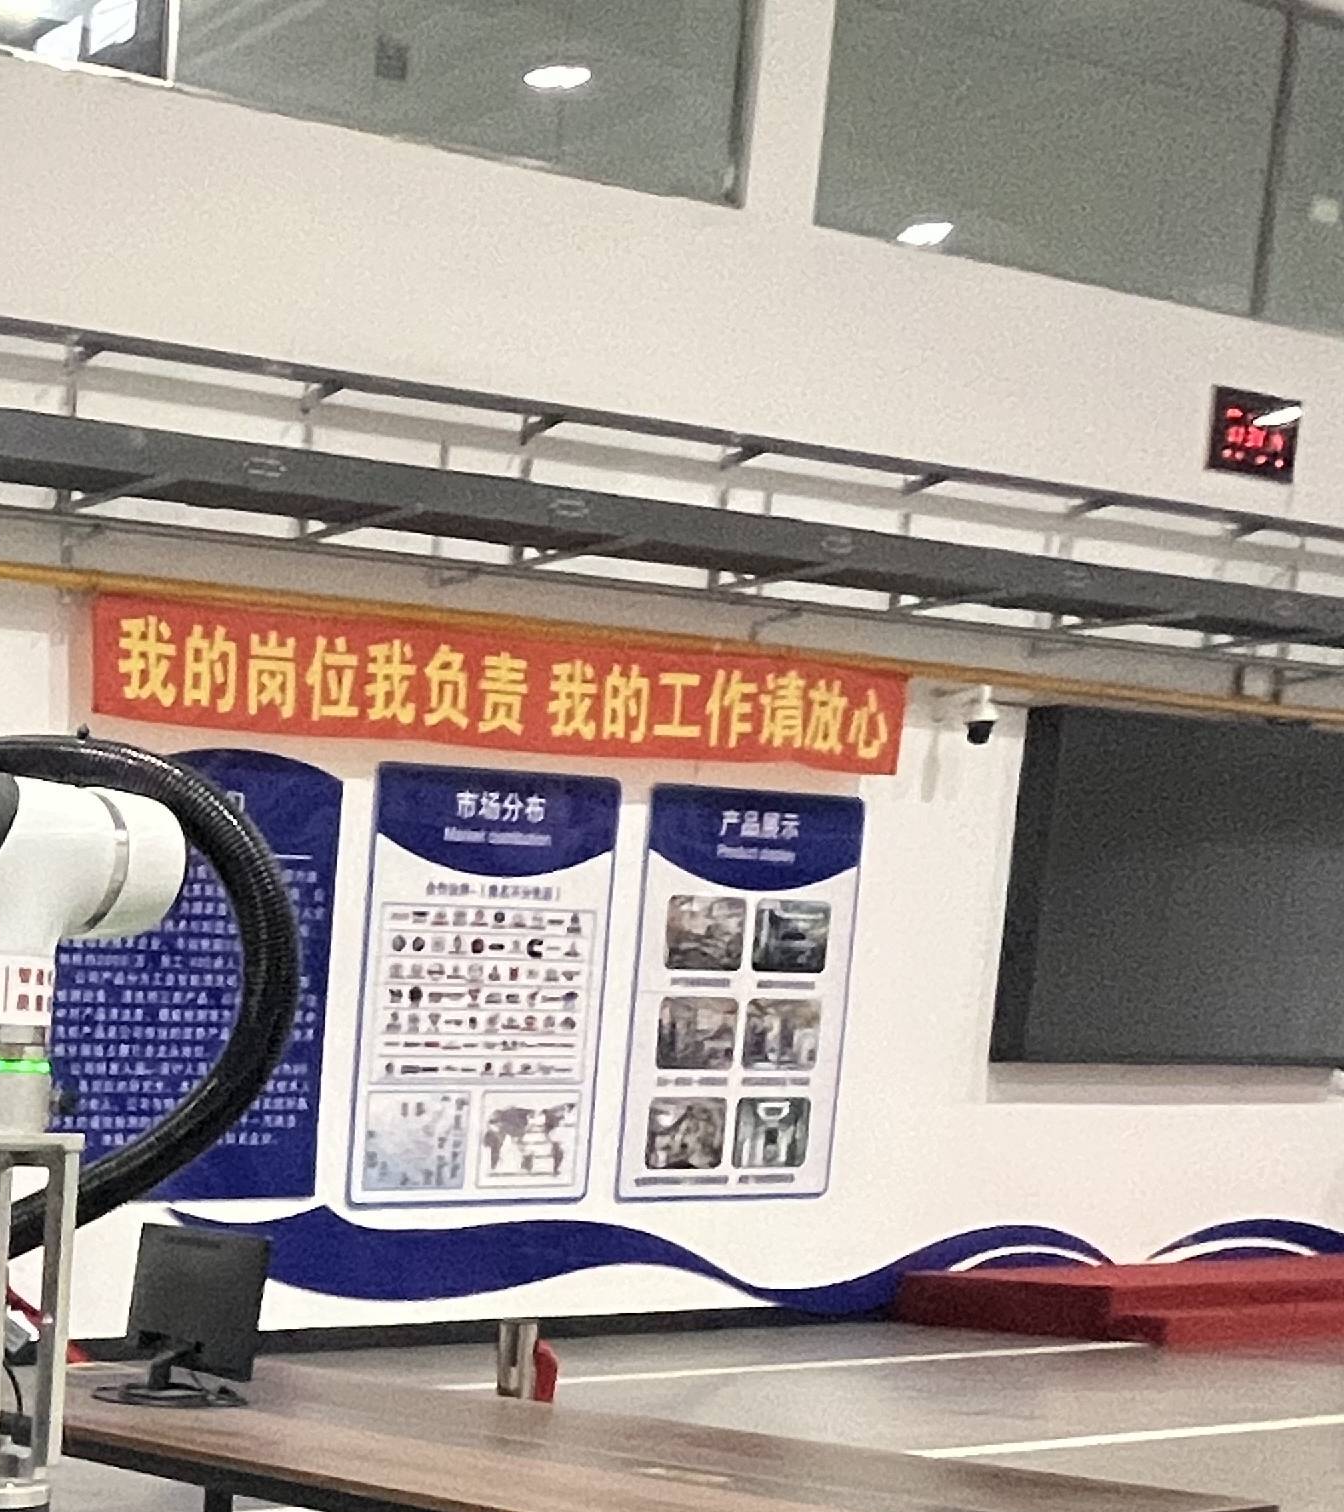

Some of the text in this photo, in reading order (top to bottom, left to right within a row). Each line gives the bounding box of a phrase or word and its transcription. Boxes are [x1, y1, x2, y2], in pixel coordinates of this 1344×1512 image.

[116, 614, 892, 759] 我的岗位我负责 我的工作请放心
[455, 789, 547, 823] 市场分布
